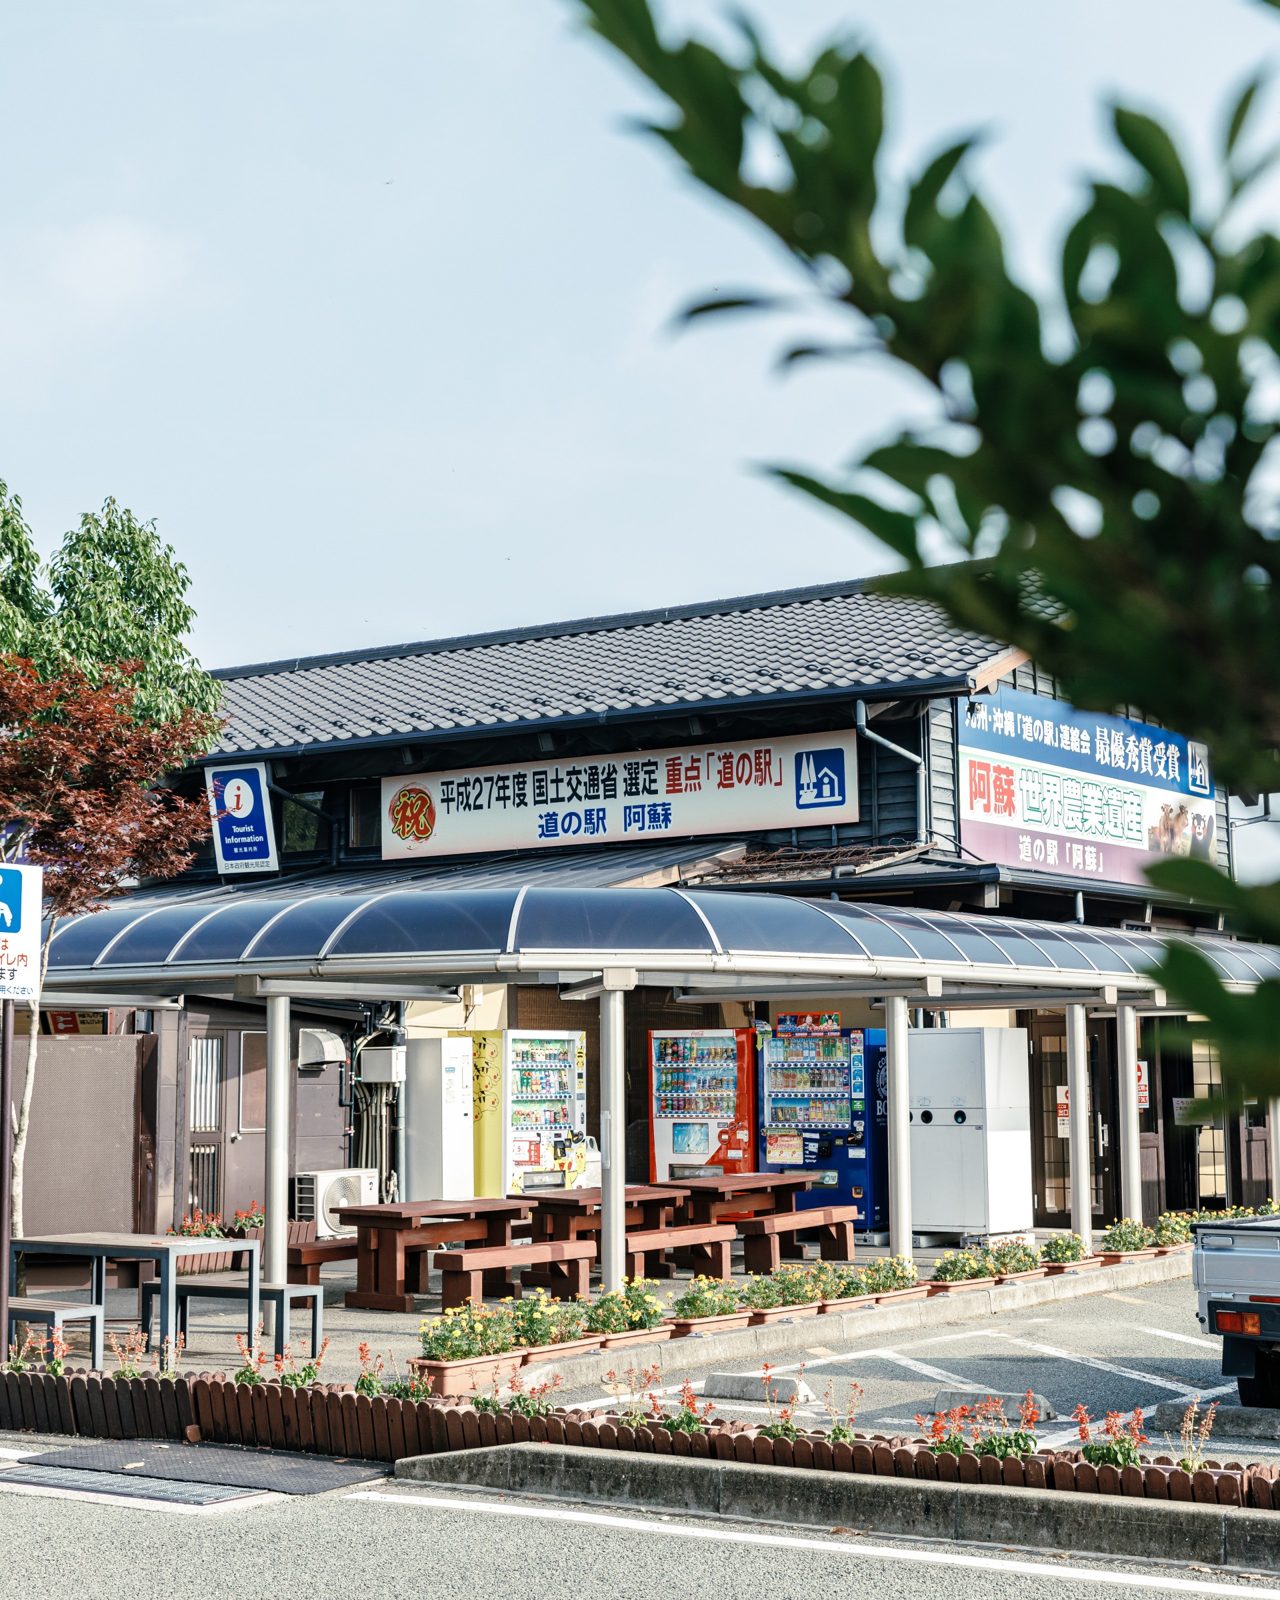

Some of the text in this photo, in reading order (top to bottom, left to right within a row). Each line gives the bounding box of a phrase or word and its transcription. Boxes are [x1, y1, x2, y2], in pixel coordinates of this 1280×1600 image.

[664, 748, 783, 796] 重点「道の駅」
[1095, 726, 1181, 783] 最優秀賞受賞
[391, 788, 433, 840] 祝
[538, 802, 672, 839] 道の駅 阿蘇
[968, 759, 1143, 843] 阿蘇 世界農業遺産
[225, 834, 264, 844] Information
[232, 824, 254, 833] Tourist
